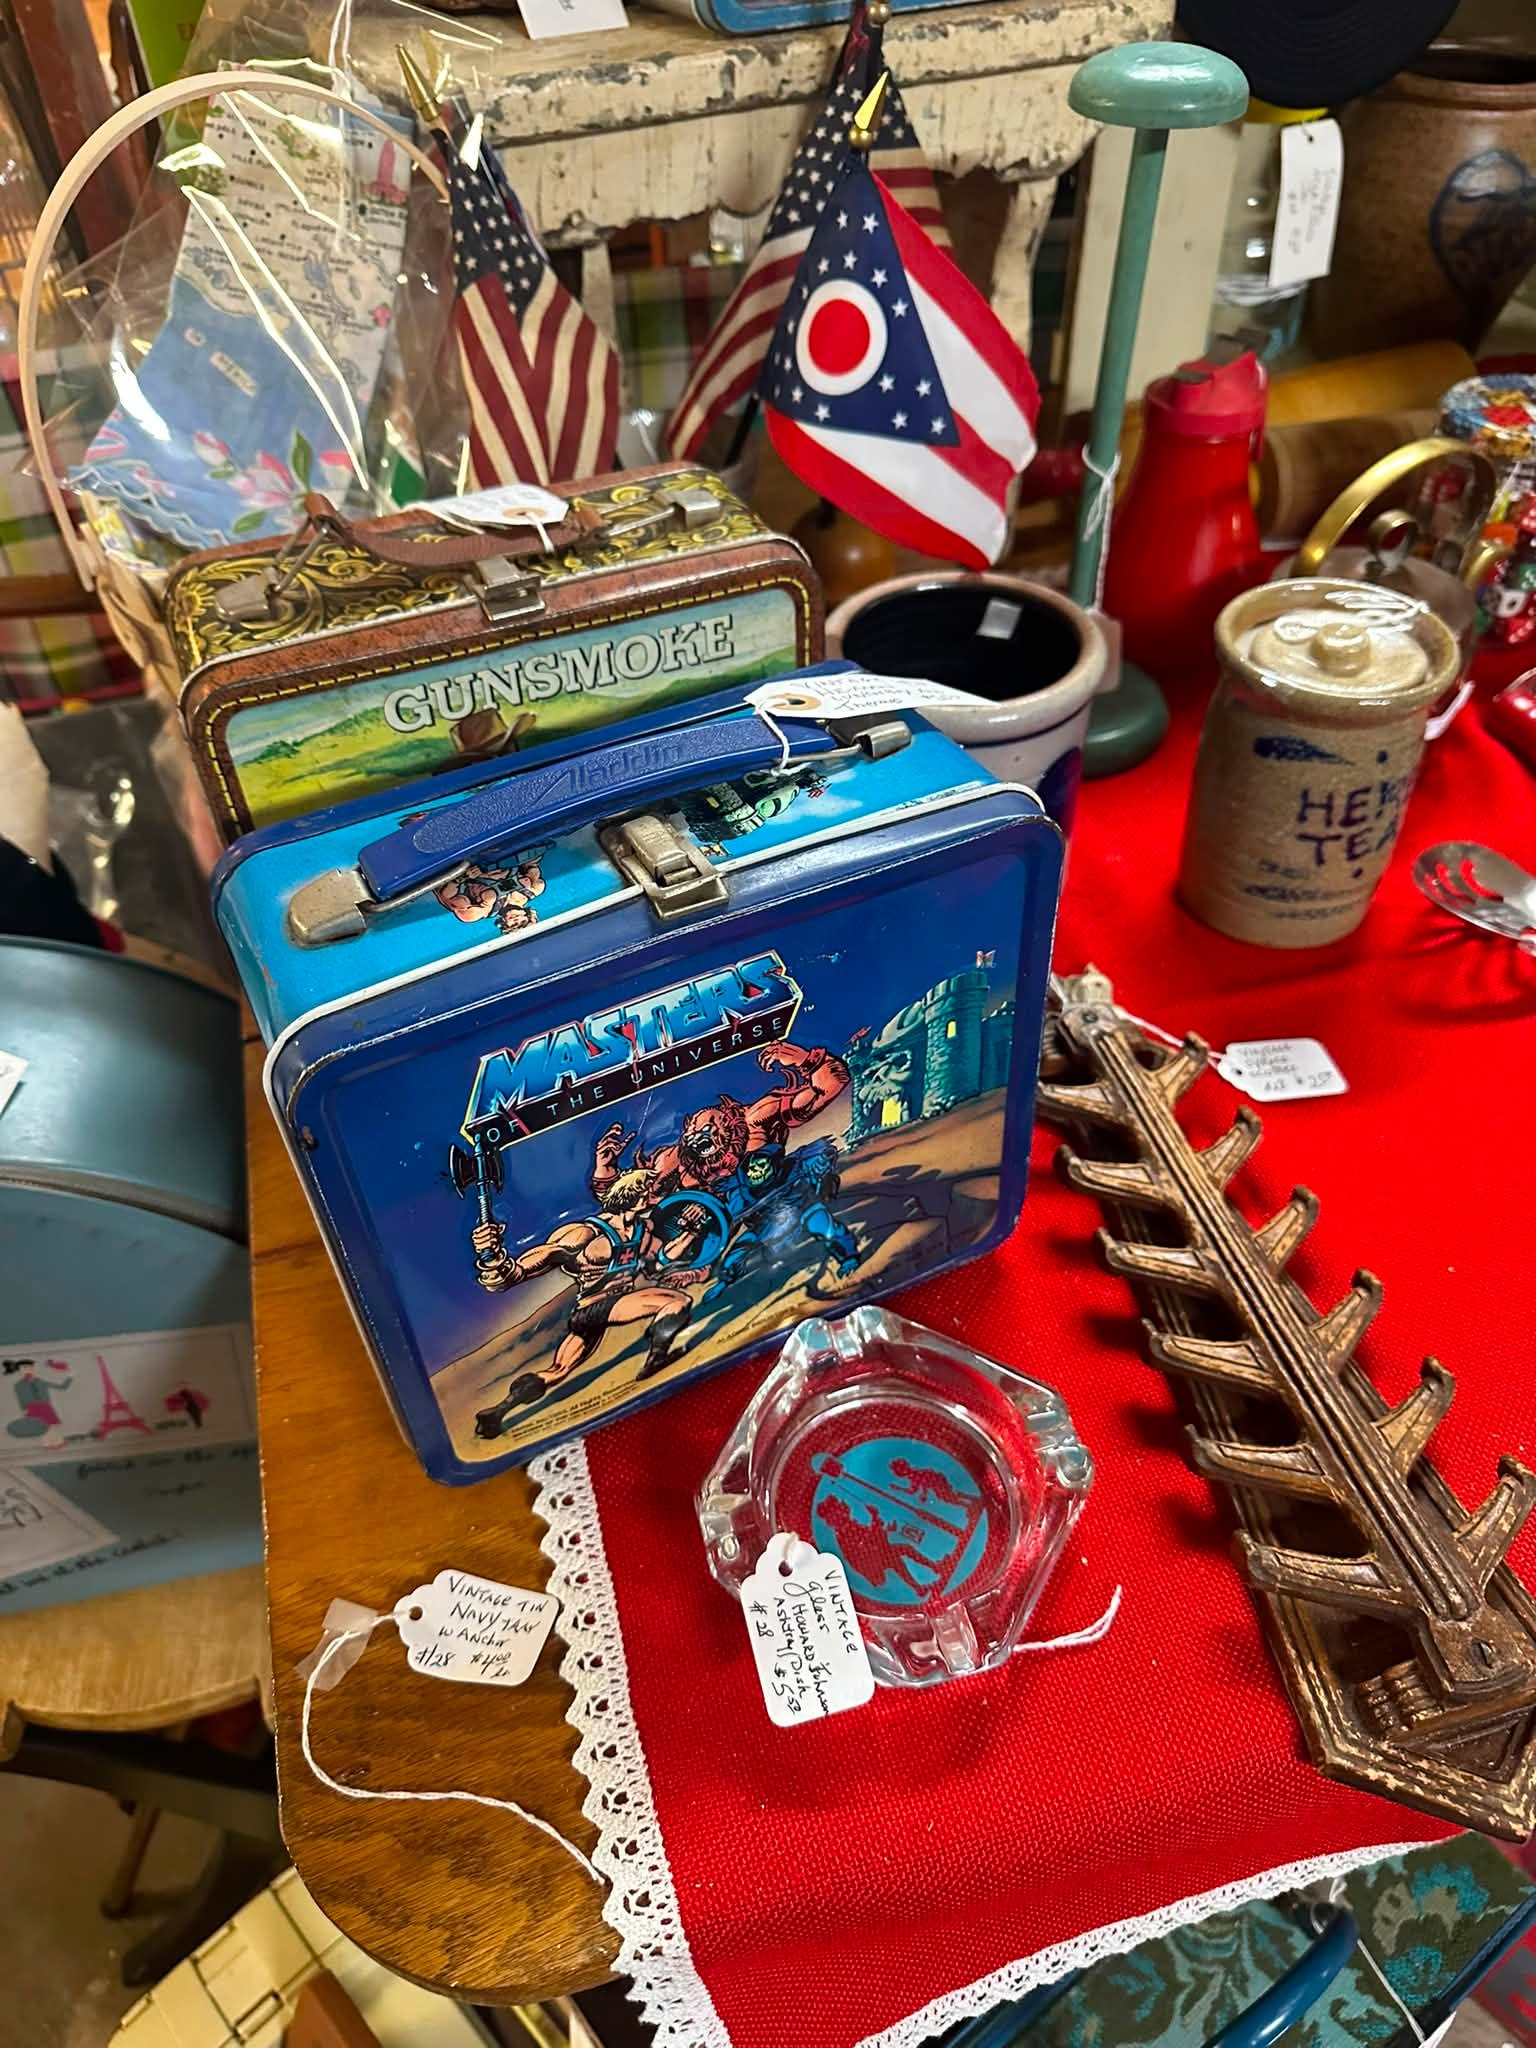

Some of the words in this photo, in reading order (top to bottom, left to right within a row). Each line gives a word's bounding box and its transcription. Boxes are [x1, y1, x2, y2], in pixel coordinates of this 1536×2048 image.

[384, 614, 734, 733] GUNSMOKE
[470, 951, 801, 1123] MASTERS
[486, 1121, 522, 1144] OF
[546, 1085, 605, 1117] THE
[630, 1017, 783, 1085] UNIVERSE
[449, 1574, 512, 1606] VINTAGE
[517, 1599, 549, 1614] TIN
[450, 1602, 503, 1633] NAVY
[792, 1603, 816, 1662] HOWARD
[825, 1569, 859, 1654] VINTAGE
